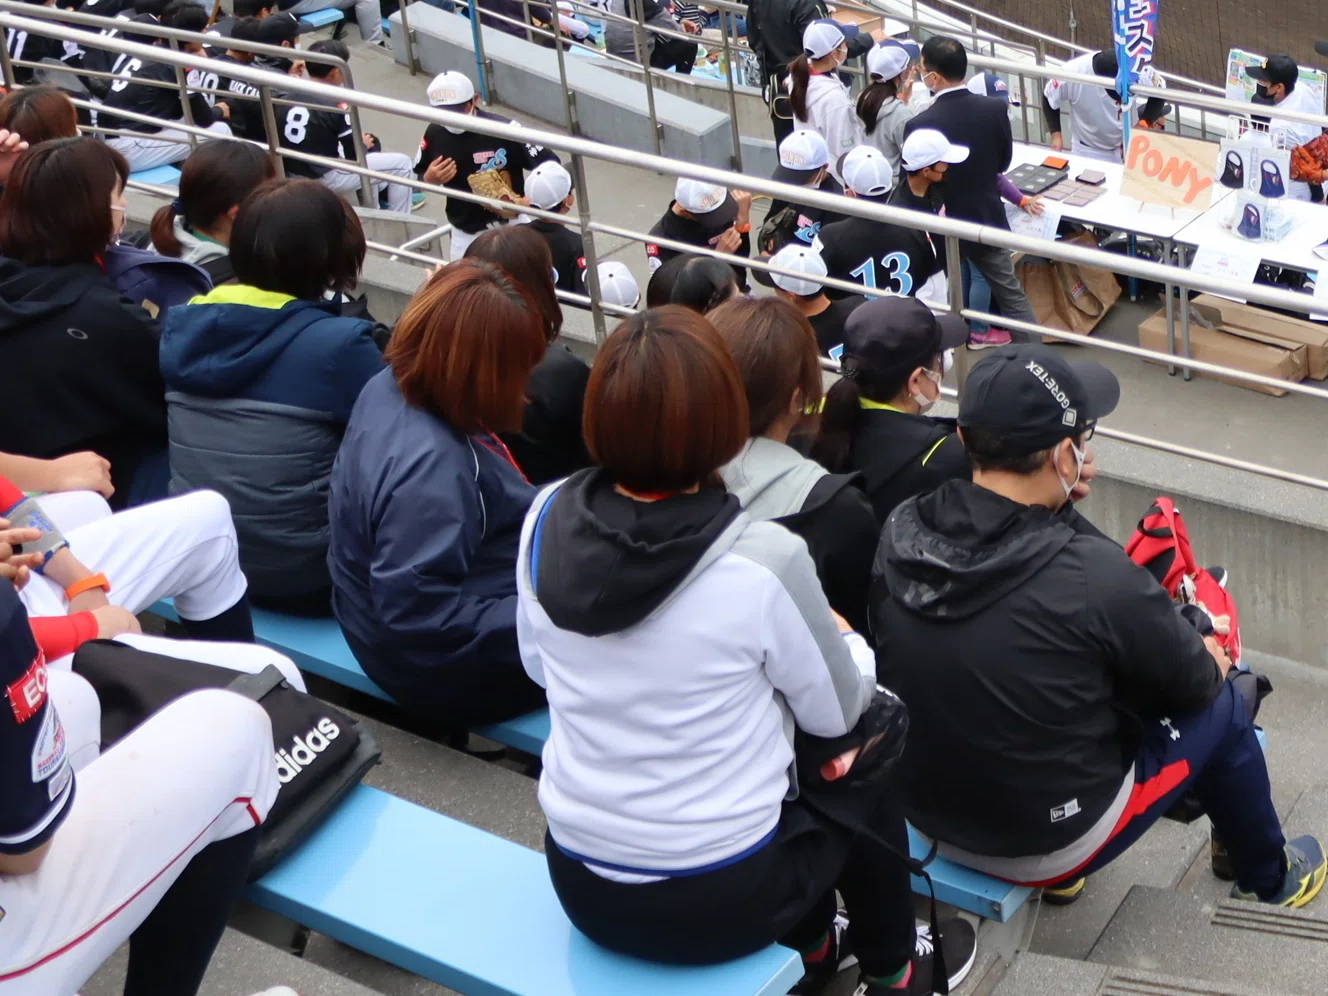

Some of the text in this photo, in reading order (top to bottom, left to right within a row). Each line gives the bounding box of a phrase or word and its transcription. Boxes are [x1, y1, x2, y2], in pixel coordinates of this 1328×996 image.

[285, 106, 310, 144] 8
[1127, 135, 1213, 204] PONY
[849, 251, 913, 300] 13
[1025, 360, 1071, 410] GORE-TEX
